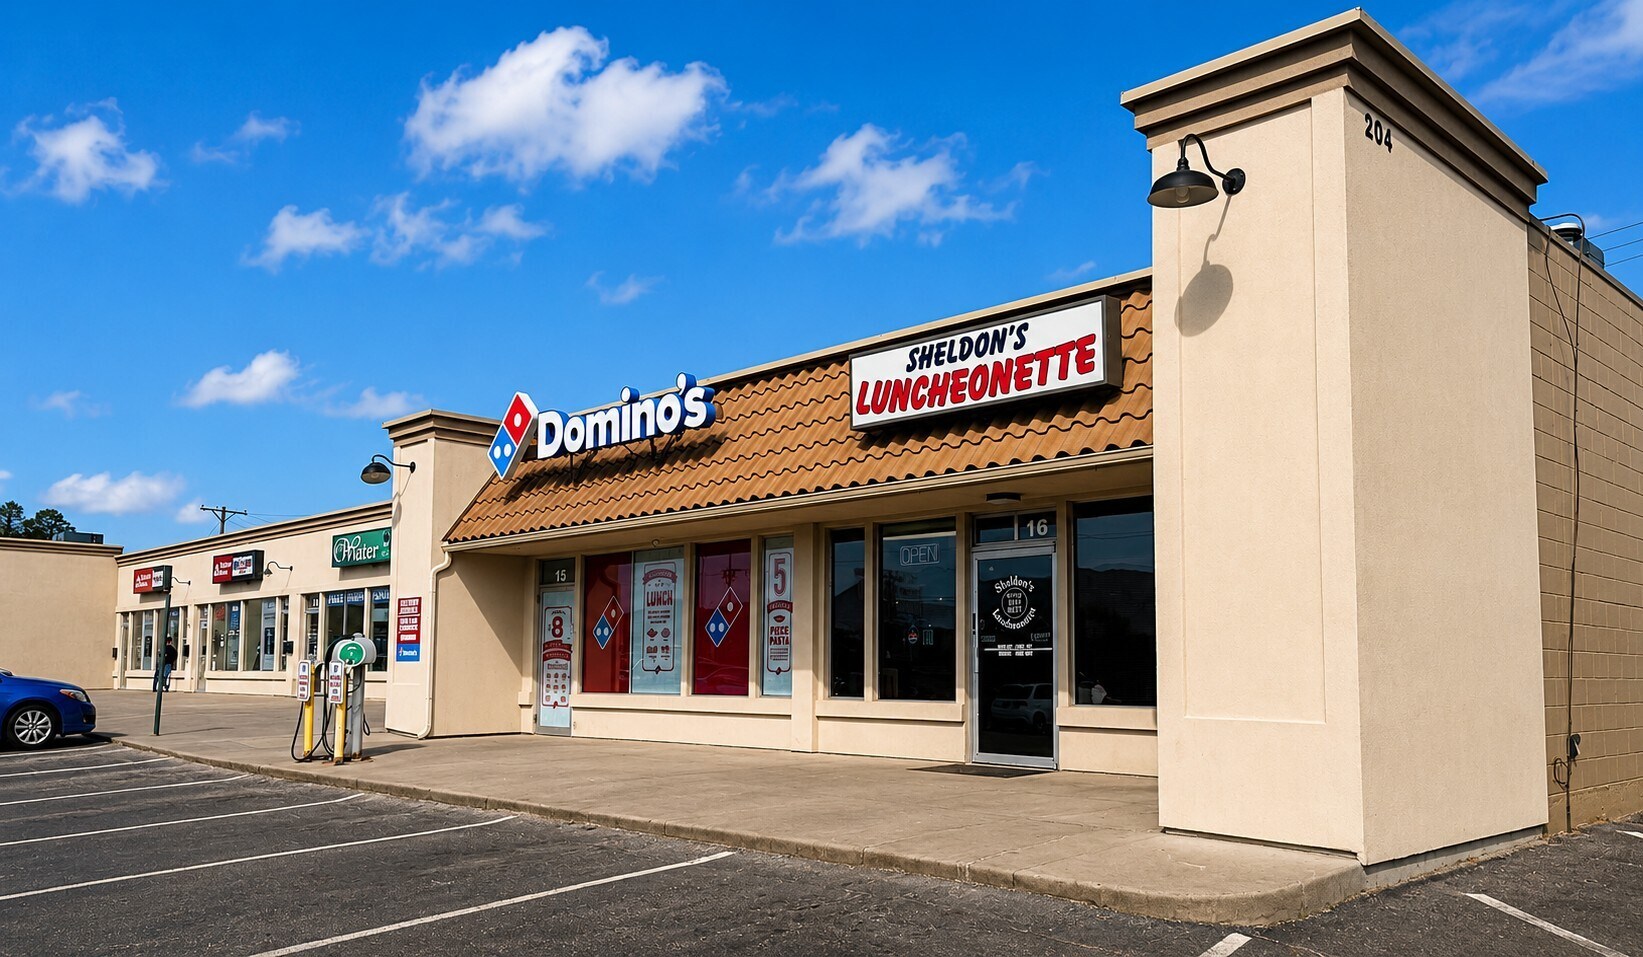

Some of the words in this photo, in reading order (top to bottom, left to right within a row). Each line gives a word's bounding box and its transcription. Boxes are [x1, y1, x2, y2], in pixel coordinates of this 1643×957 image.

[1364, 113, 1393, 153] 204
[905, 322, 1029, 372] SHELDON'S
[856, 333, 1097, 415] LUNCHEONETTE
[537, 372, 716, 460] Domino's
[1026, 519, 1048, 536] 16
[903, 546, 937, 564] OPEN
[555, 569, 567, 582] 15
[774, 558, 786, 596] 5
[647, 590, 673, 607] LUNCH
[552, 616, 563, 638] 8
